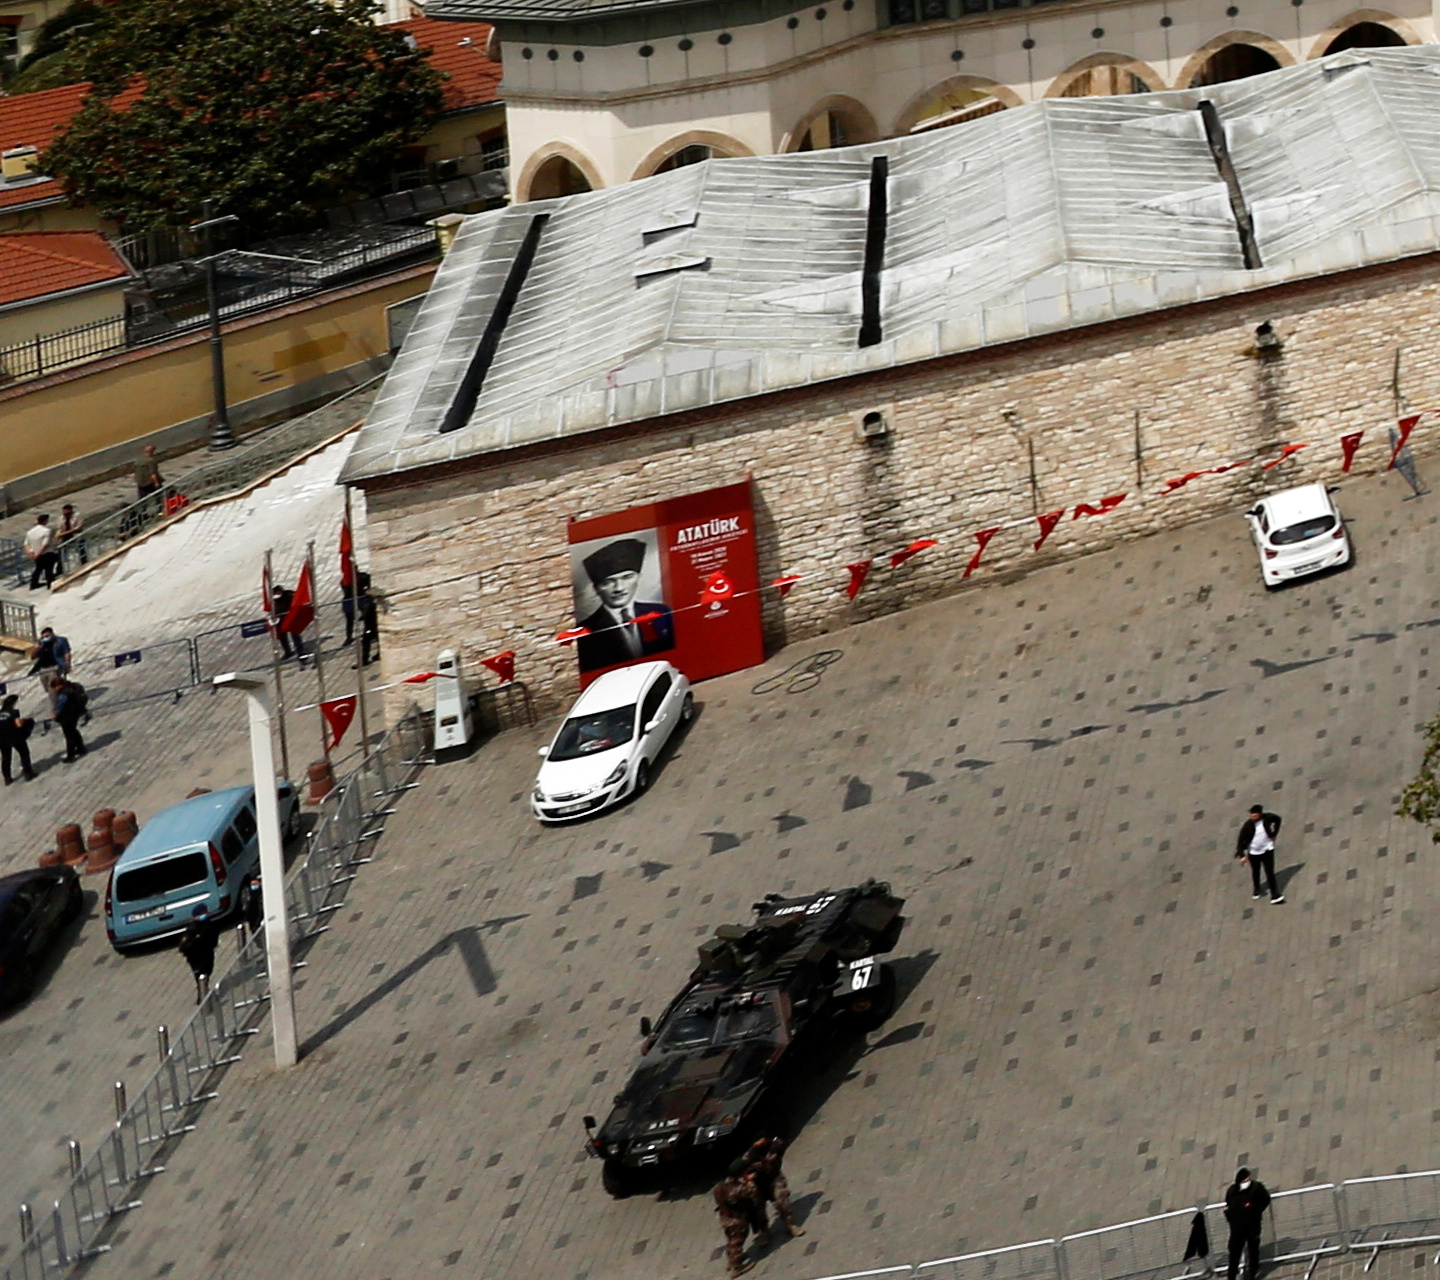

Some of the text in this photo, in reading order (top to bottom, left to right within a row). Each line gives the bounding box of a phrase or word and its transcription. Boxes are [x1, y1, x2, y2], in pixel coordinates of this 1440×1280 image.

[677, 516, 740, 545] ATATÜRK
[805, 895, 837, 915] 67
[851, 965, 872, 991] 67
